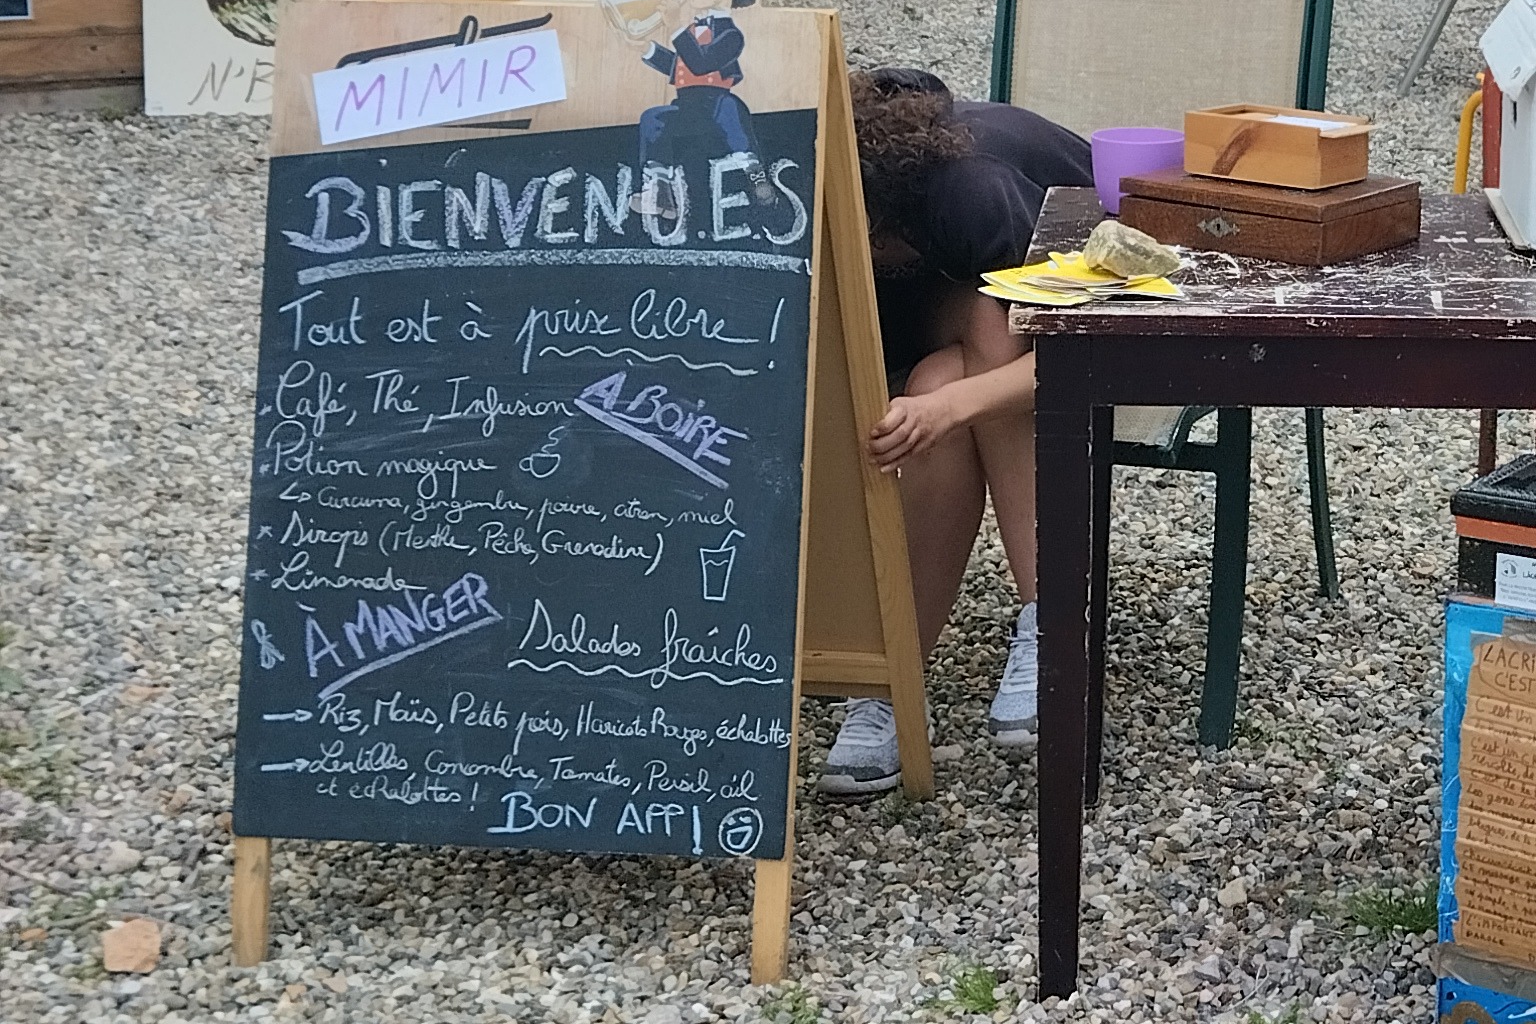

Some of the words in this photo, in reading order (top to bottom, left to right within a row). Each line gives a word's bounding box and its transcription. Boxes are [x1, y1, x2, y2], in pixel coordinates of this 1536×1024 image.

[334, 44, 537, 132] MIMIR
[279, 290, 367, 351] Tout
[385, 299, 442, 343] est
[460, 301, 492, 341] à
[514, 298, 621, 373] prix
[611, 385, 749, 466] BOIRE
[266, 420, 368, 476] Potion
[376, 450, 497, 499] magique
[678, 498, 737, 526] miel
[271, 551, 428, 591] Limonade
[343, 573, 503, 659] MANGER
[519, 598, 641, 657] Salades
[1495, 670, 1536, 694] C'EST
[450, 691, 508, 730] Petits
[577, 701, 648, 737] Haricots
[317, 777, 338, 796] et
[487, 791, 597, 834] BON
